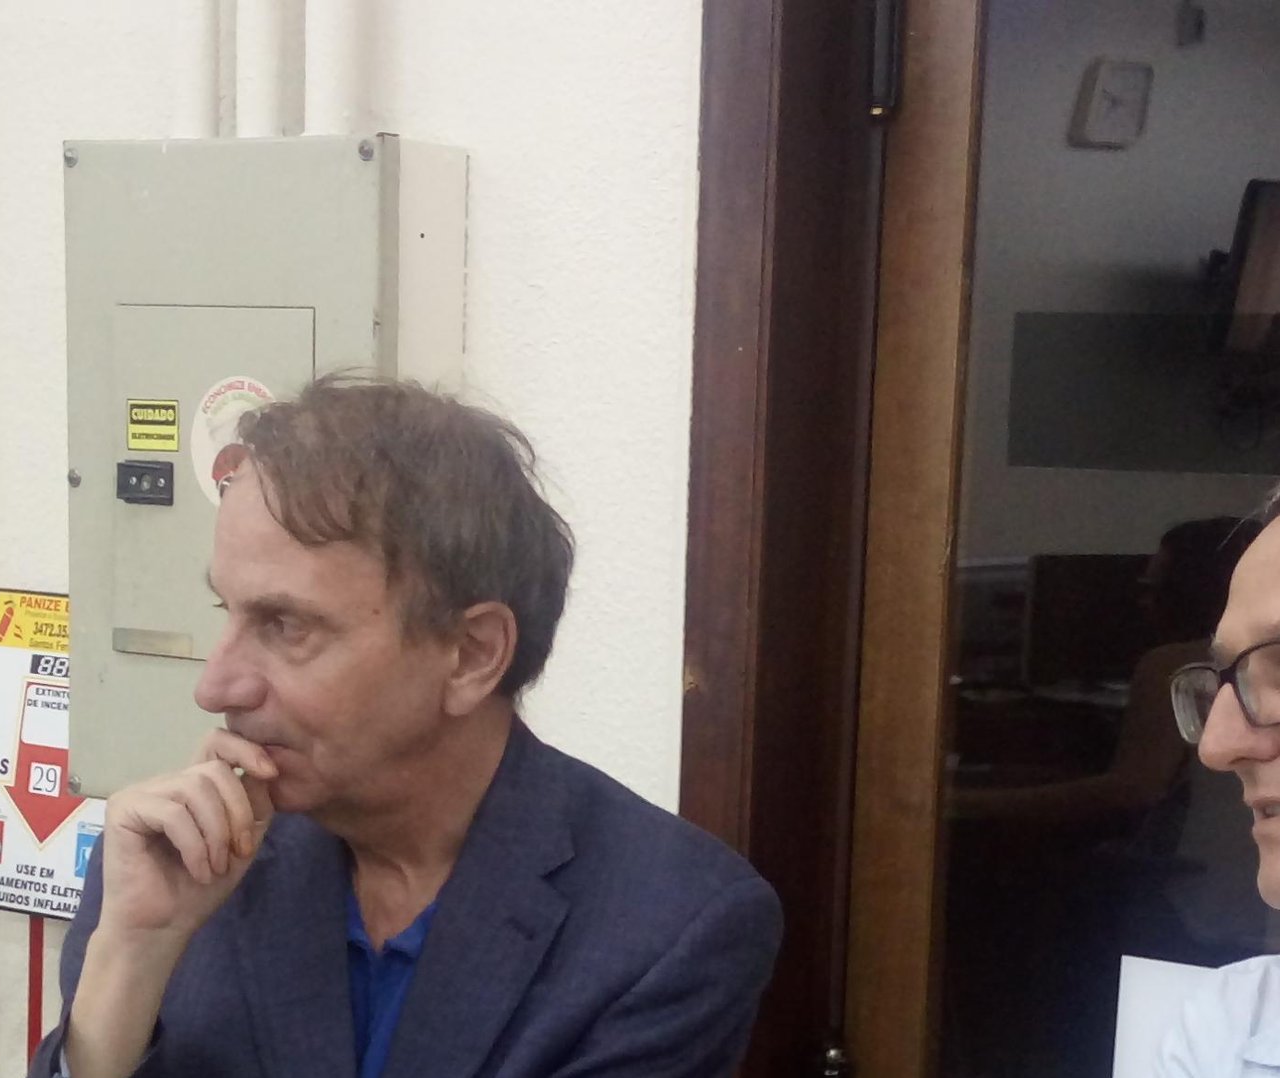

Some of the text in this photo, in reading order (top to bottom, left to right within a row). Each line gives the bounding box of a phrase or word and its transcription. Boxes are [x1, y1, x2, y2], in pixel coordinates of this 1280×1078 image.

[131, 408, 175, 421] CUIDADO
[20, 596, 61, 611] PANIZE
[27, 698, 38, 707] DE
[32, 765, 58, 793] 29
[16, 864, 54, 878] USE EM
